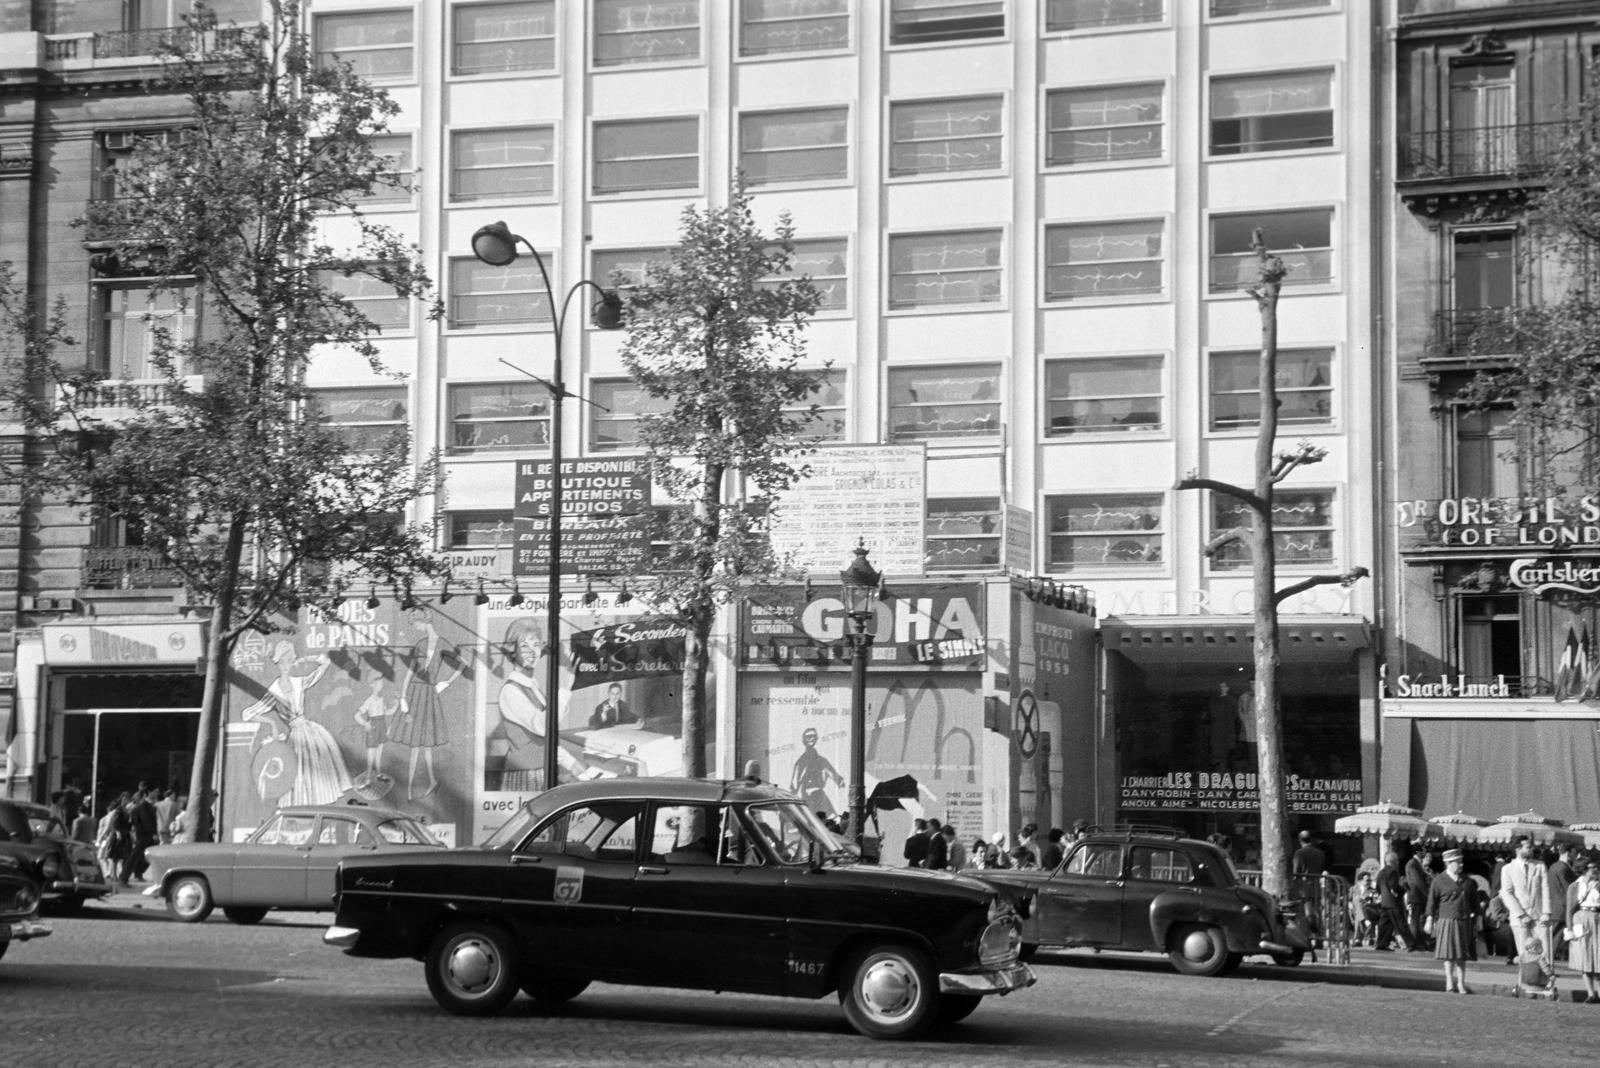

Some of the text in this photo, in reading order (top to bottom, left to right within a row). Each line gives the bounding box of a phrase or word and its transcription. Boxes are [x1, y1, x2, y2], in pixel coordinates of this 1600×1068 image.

[521, 464, 534, 475] IL
[537, 462, 573, 475] RETE
[521, 489, 643, 503] APPRTEMENTS
[538, 501, 623, 514] SUDIOS
[538, 533, 574, 541] TOTE
[488, 600, 511, 610] une
[519, 598, 548, 612] copi
[305, 601, 375, 625] MDES
[801, 597, 982, 643] GOHA
[306, 624, 389, 648] de PARIS
[916, 643, 934, 662] LE
[1397, 673, 1510, 697] Snack-Lunch
[751, 693, 821, 705] ne ressemble
[1168, 772, 1192, 788] LES
[1313, 779, 1361, 791] AZNAVOUR
[1121, 800, 1157, 808] ANOUK
[1330, 793, 1361, 801] BLAIN
[482, 800, 514, 811] avec
[557, 882, 579, 898] G7
